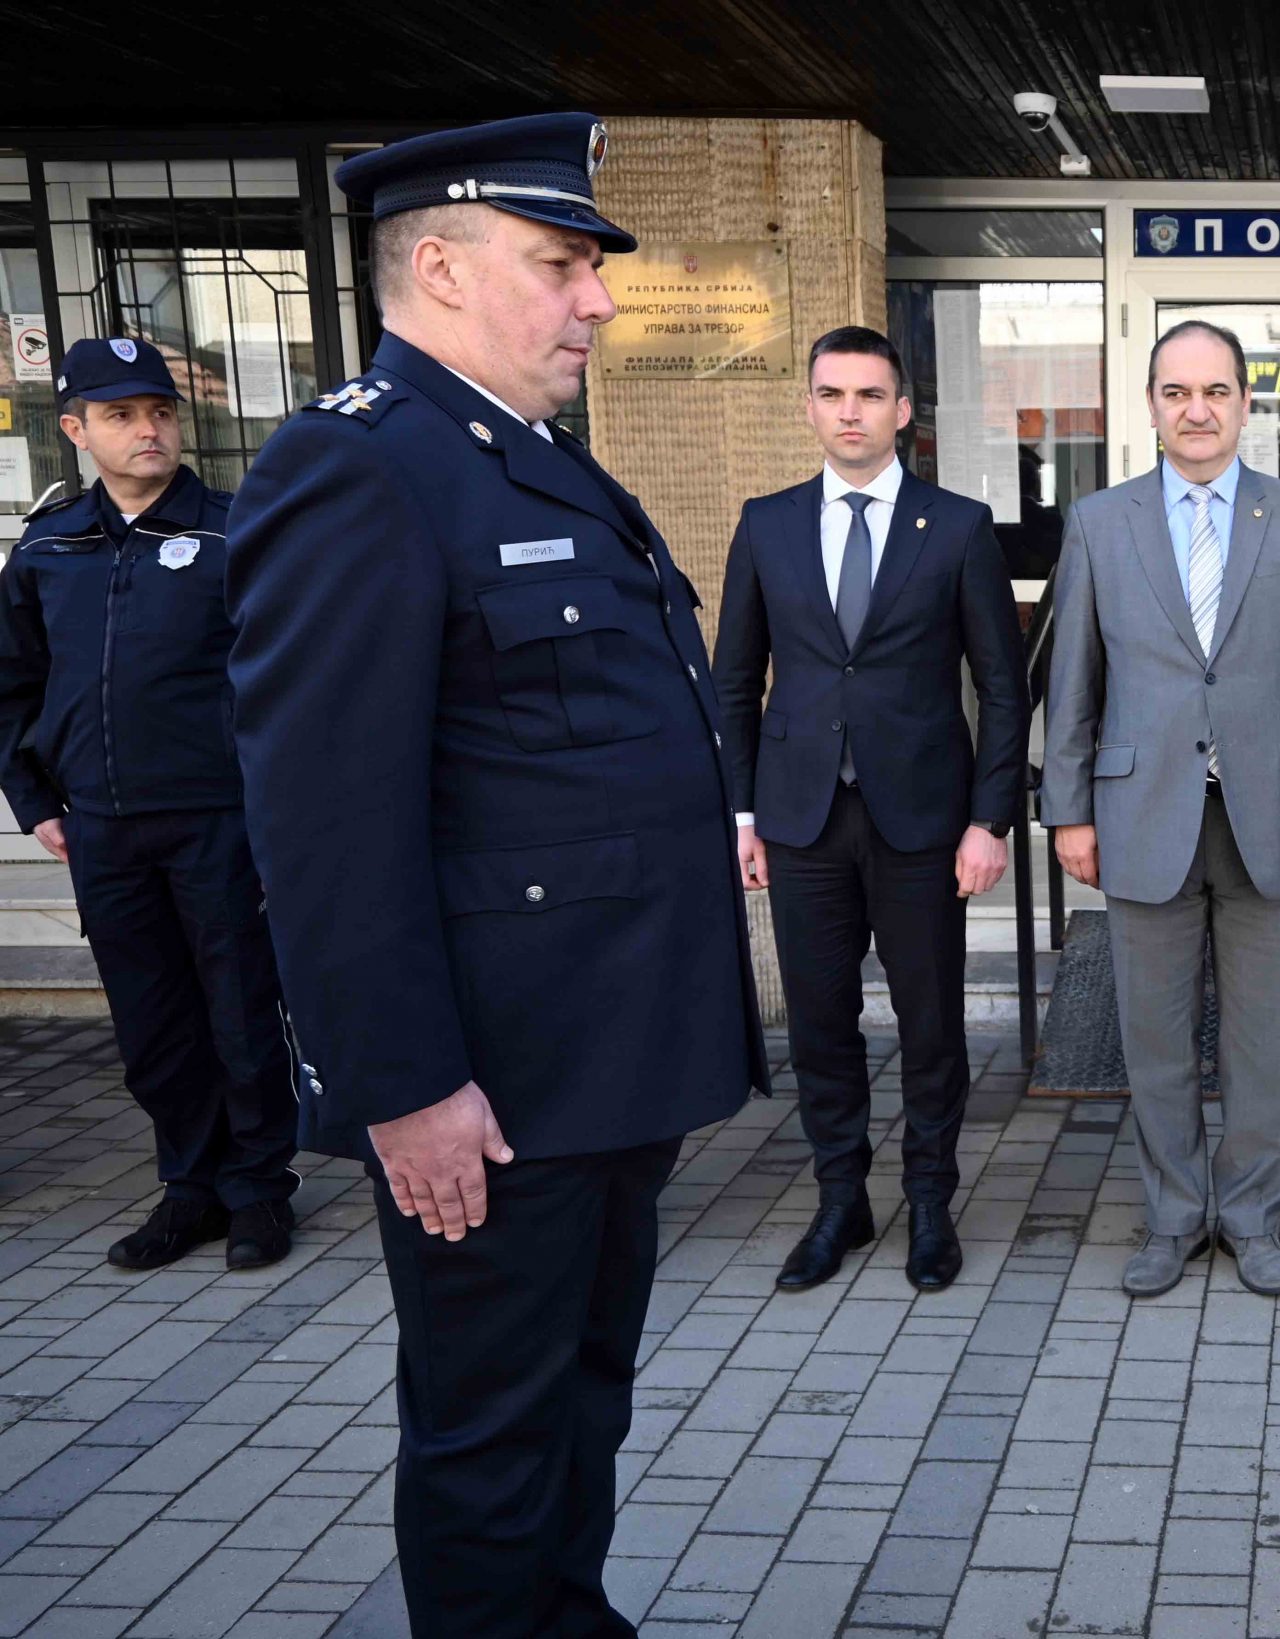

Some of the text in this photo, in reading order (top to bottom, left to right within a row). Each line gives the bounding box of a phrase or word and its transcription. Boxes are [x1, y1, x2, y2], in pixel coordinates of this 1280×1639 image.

[627, 285, 700, 293] РЕПУБЛИКА
[616, 303, 770, 314] МИНИСТАРСТВО ФИНАНСИЈА
[643, 323, 745, 334] УПРАВА ЗА ТРЕЗОР
[704, 364, 769, 372] СВЛАЈНАЦ
